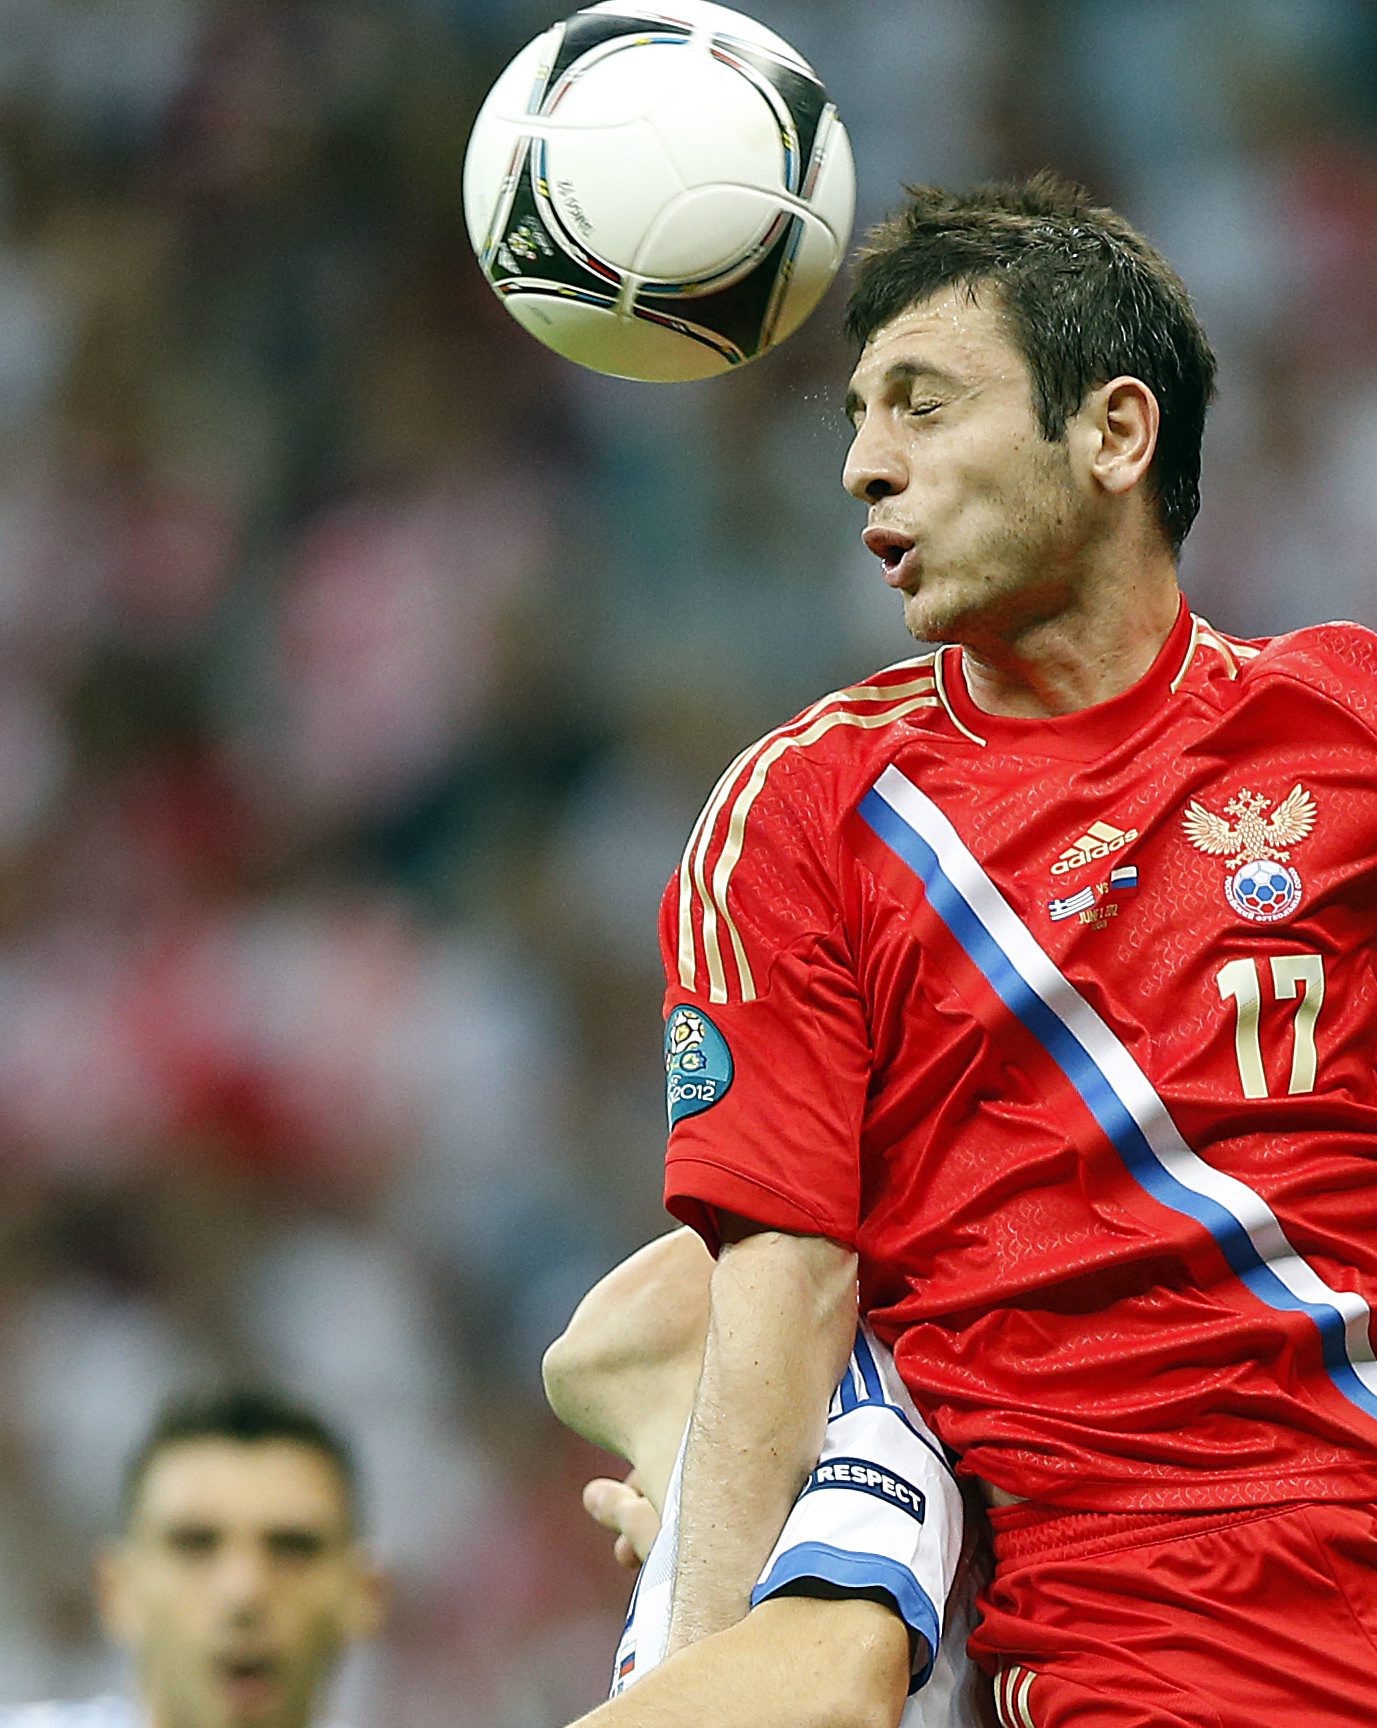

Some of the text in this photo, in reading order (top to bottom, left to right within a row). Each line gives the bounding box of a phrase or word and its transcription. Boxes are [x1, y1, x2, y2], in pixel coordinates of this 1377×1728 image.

[1050, 828, 1140, 875] adidas
[1216, 954, 1326, 1099] 17
[669, 1083, 716, 1103] 2012
[816, 1463, 922, 1512] RESPECT
